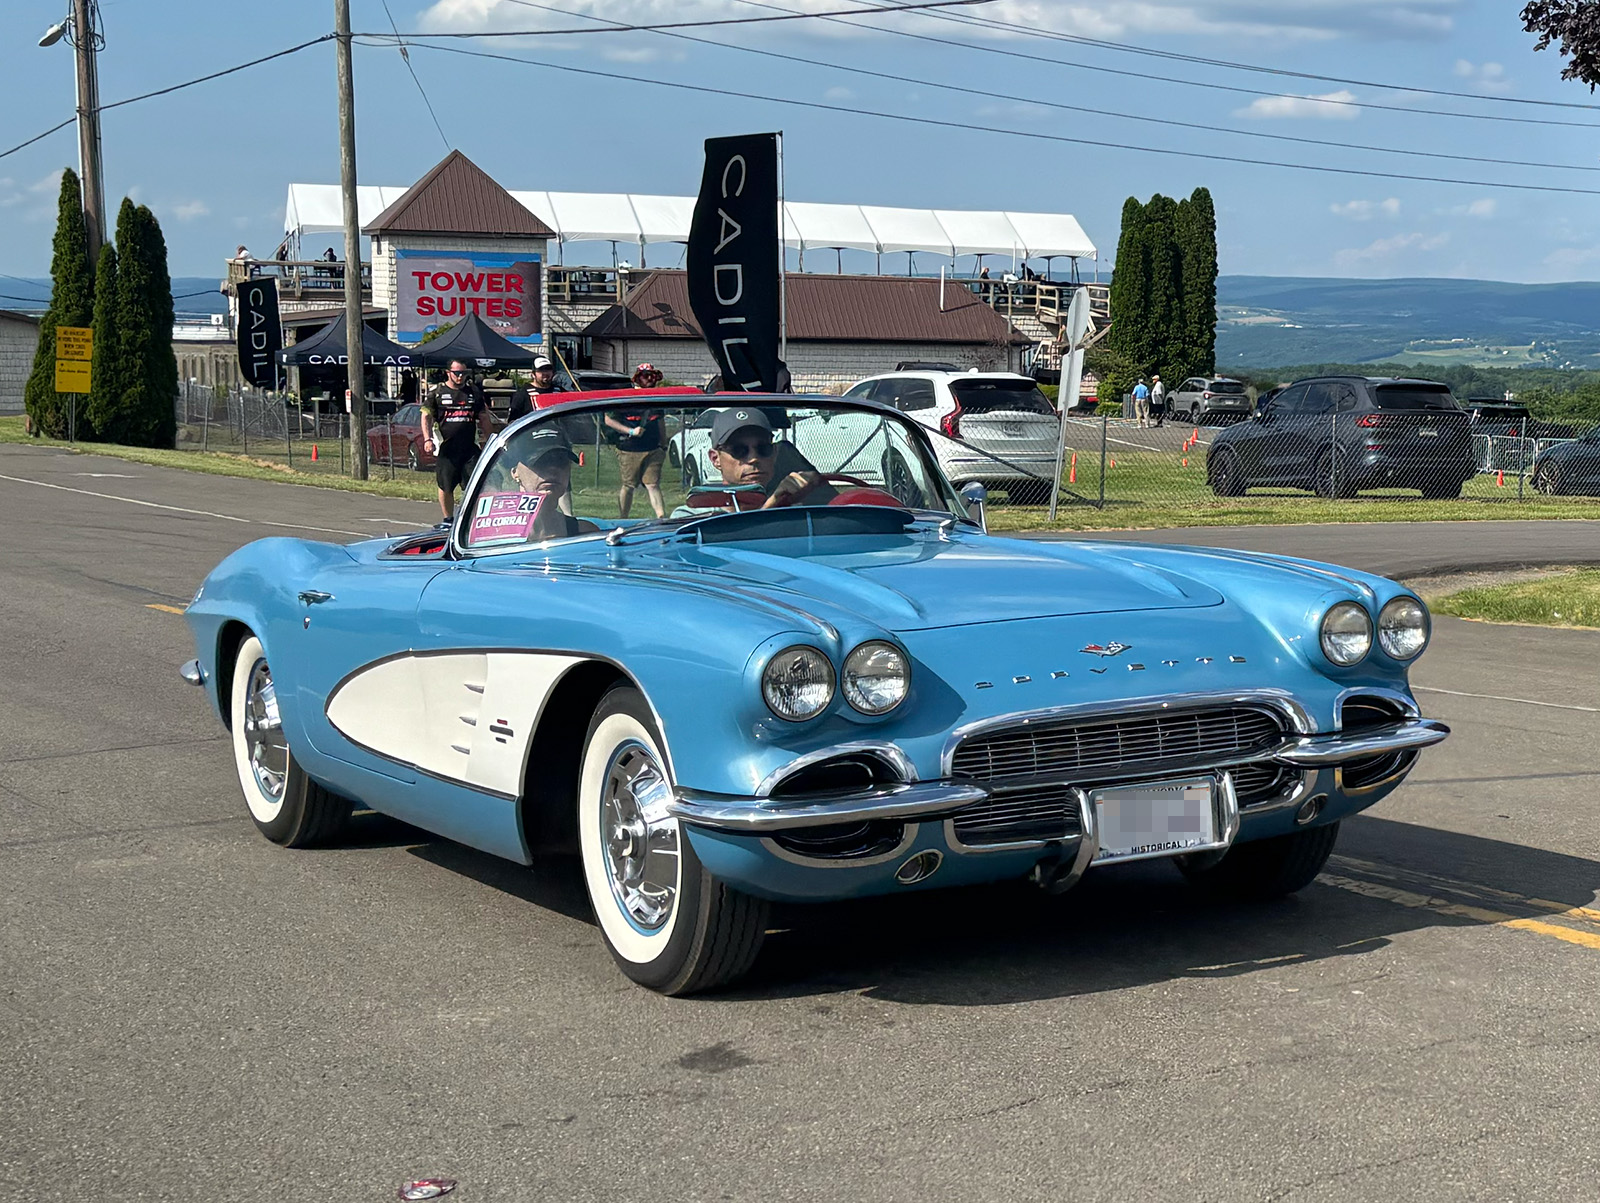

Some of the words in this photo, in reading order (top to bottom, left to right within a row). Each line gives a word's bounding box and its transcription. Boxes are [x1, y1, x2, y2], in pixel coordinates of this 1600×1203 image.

[411, 271, 524, 294] TOWER
[416, 296, 523, 318] SUITES
[308, 354, 410, 365] CADLAC
[518, 497, 539, 511] 26
[476, 518, 491, 528] CAR
[492, 516, 527, 526] CORRAL
[1131, 840, 1182, 855] HISTORICAL
